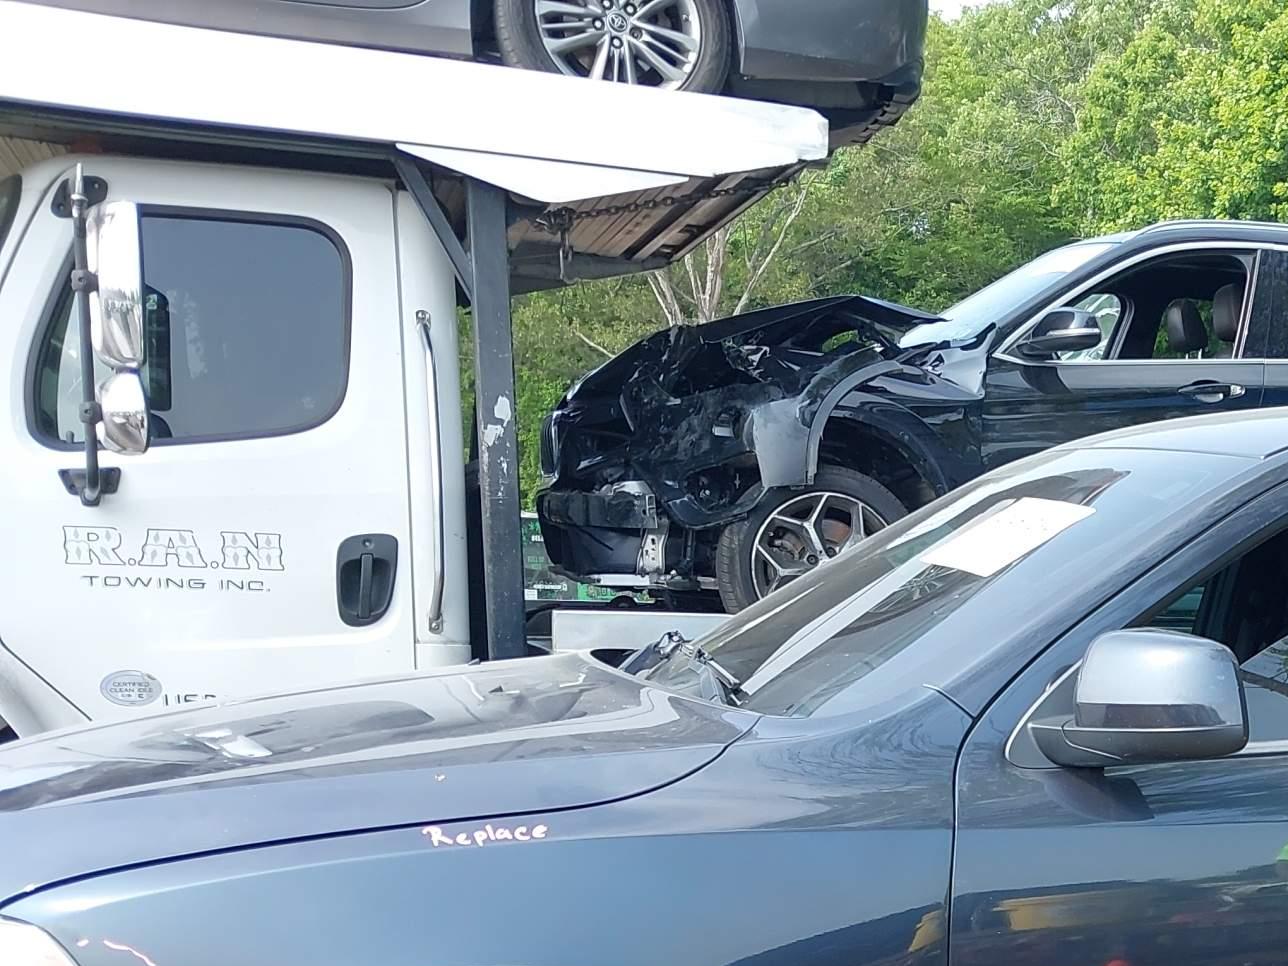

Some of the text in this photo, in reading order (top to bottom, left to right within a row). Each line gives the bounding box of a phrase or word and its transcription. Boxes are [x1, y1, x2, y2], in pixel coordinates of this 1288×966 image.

[82, 575, 271, 592] TOWING INC.
[422, 823, 548, 847] Replace
